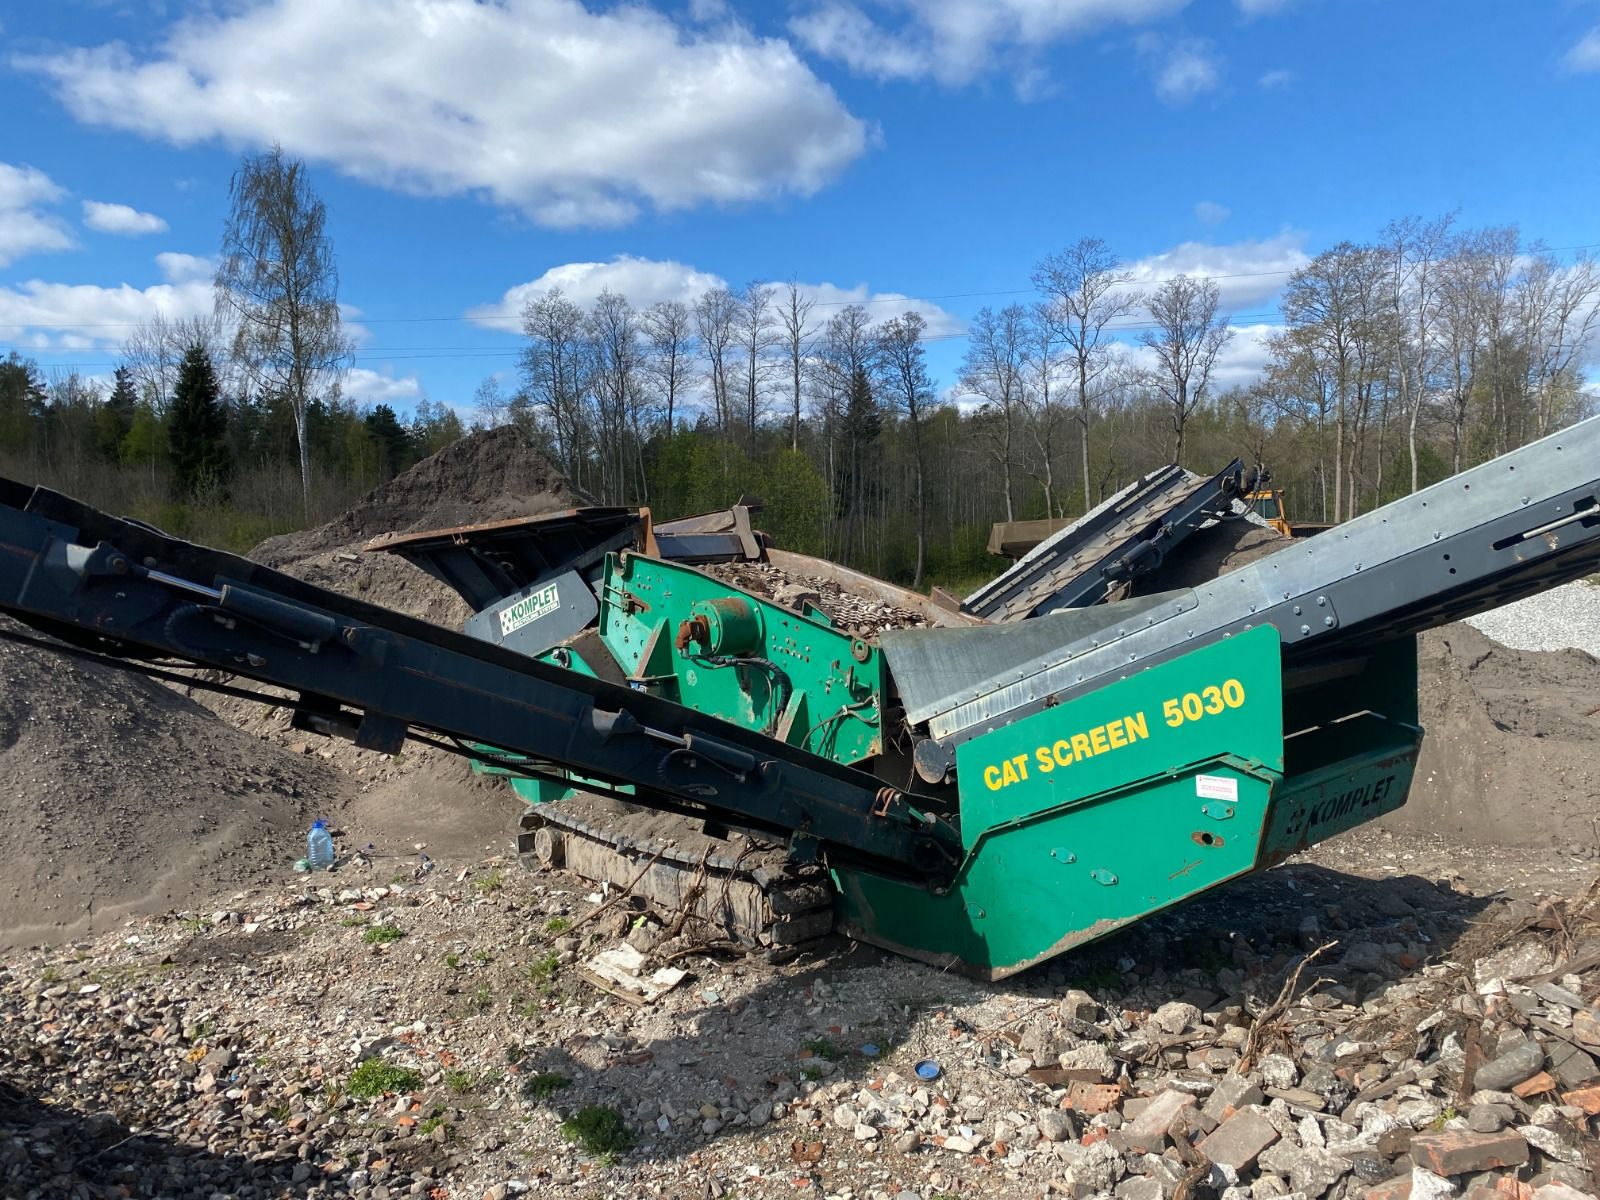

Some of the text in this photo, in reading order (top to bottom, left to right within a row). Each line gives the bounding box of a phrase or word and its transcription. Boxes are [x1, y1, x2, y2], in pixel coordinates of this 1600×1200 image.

[511, 586, 556, 621] KOMPLET
[984, 679, 1245, 791] CAT SCREEN 5030
[1309, 775, 1395, 826] KOMPLET
